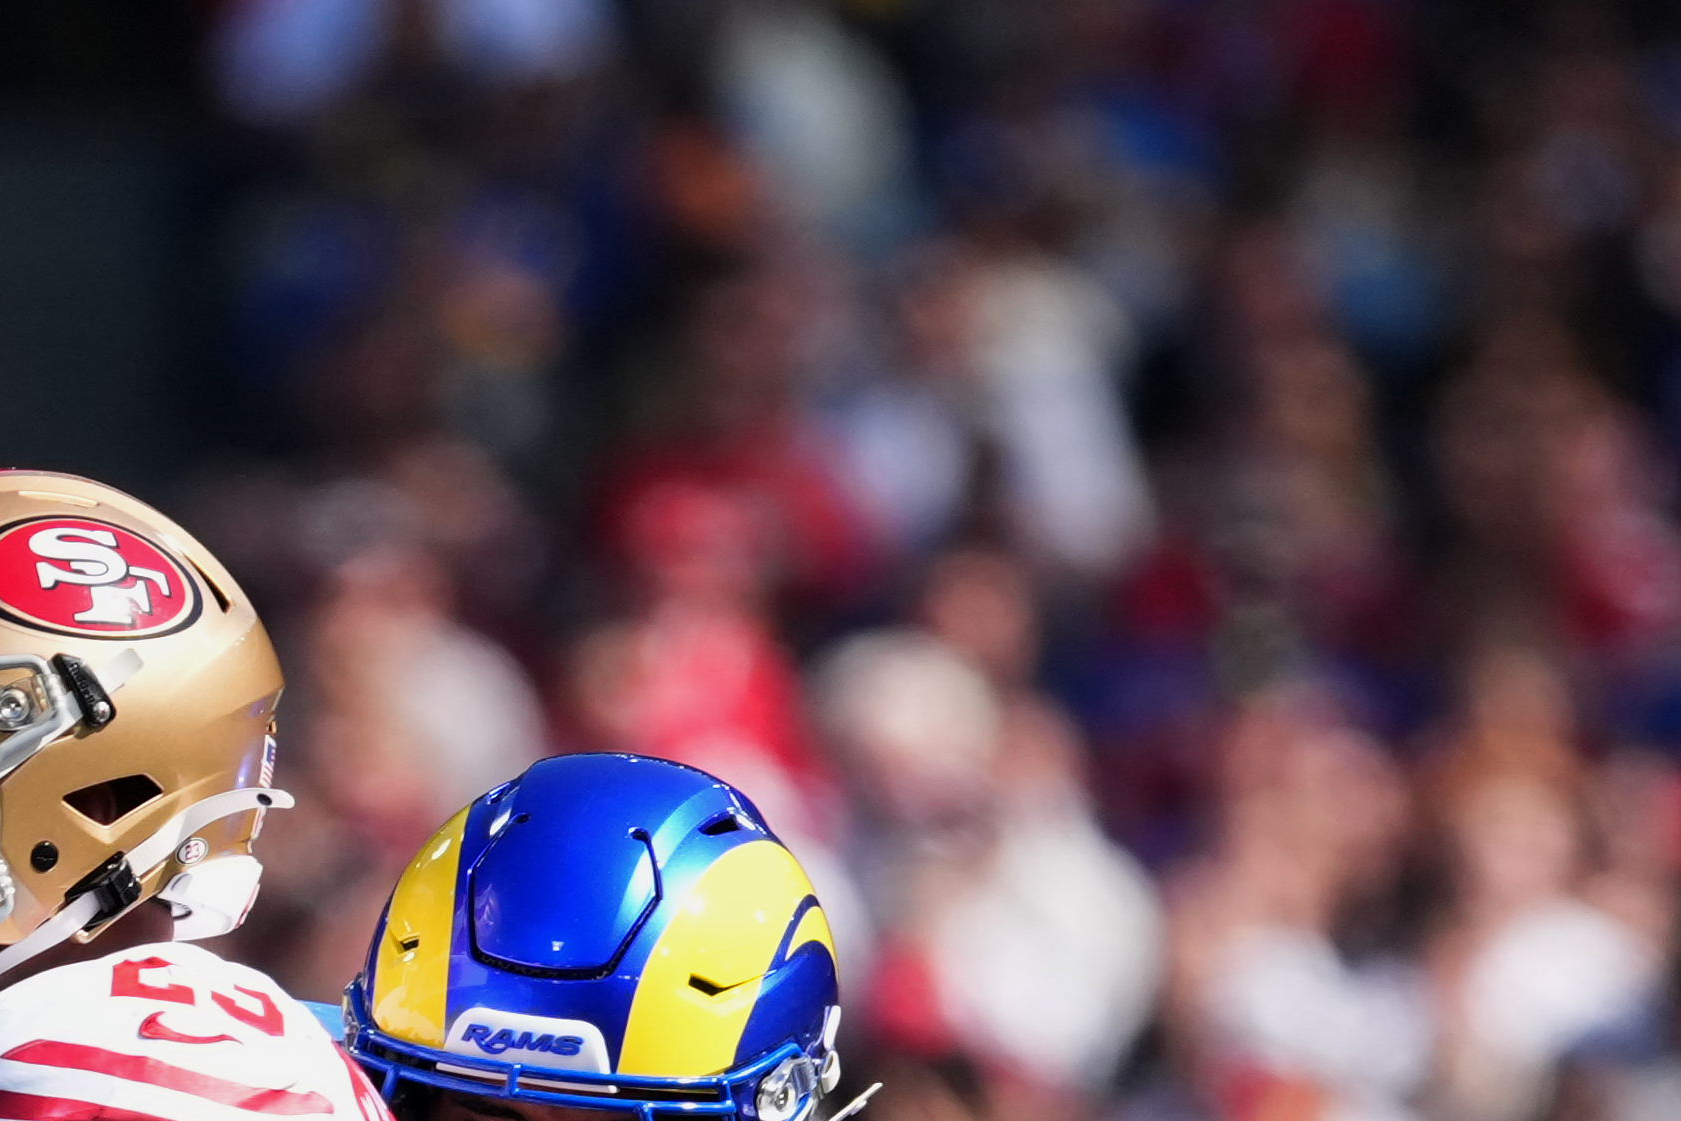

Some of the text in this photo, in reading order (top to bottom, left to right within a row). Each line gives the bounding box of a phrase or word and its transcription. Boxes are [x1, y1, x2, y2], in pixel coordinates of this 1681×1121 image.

[28, 527, 172, 626] SF
[185, 842, 200, 860] 23
[461, 1023, 584, 1056] RAMS
